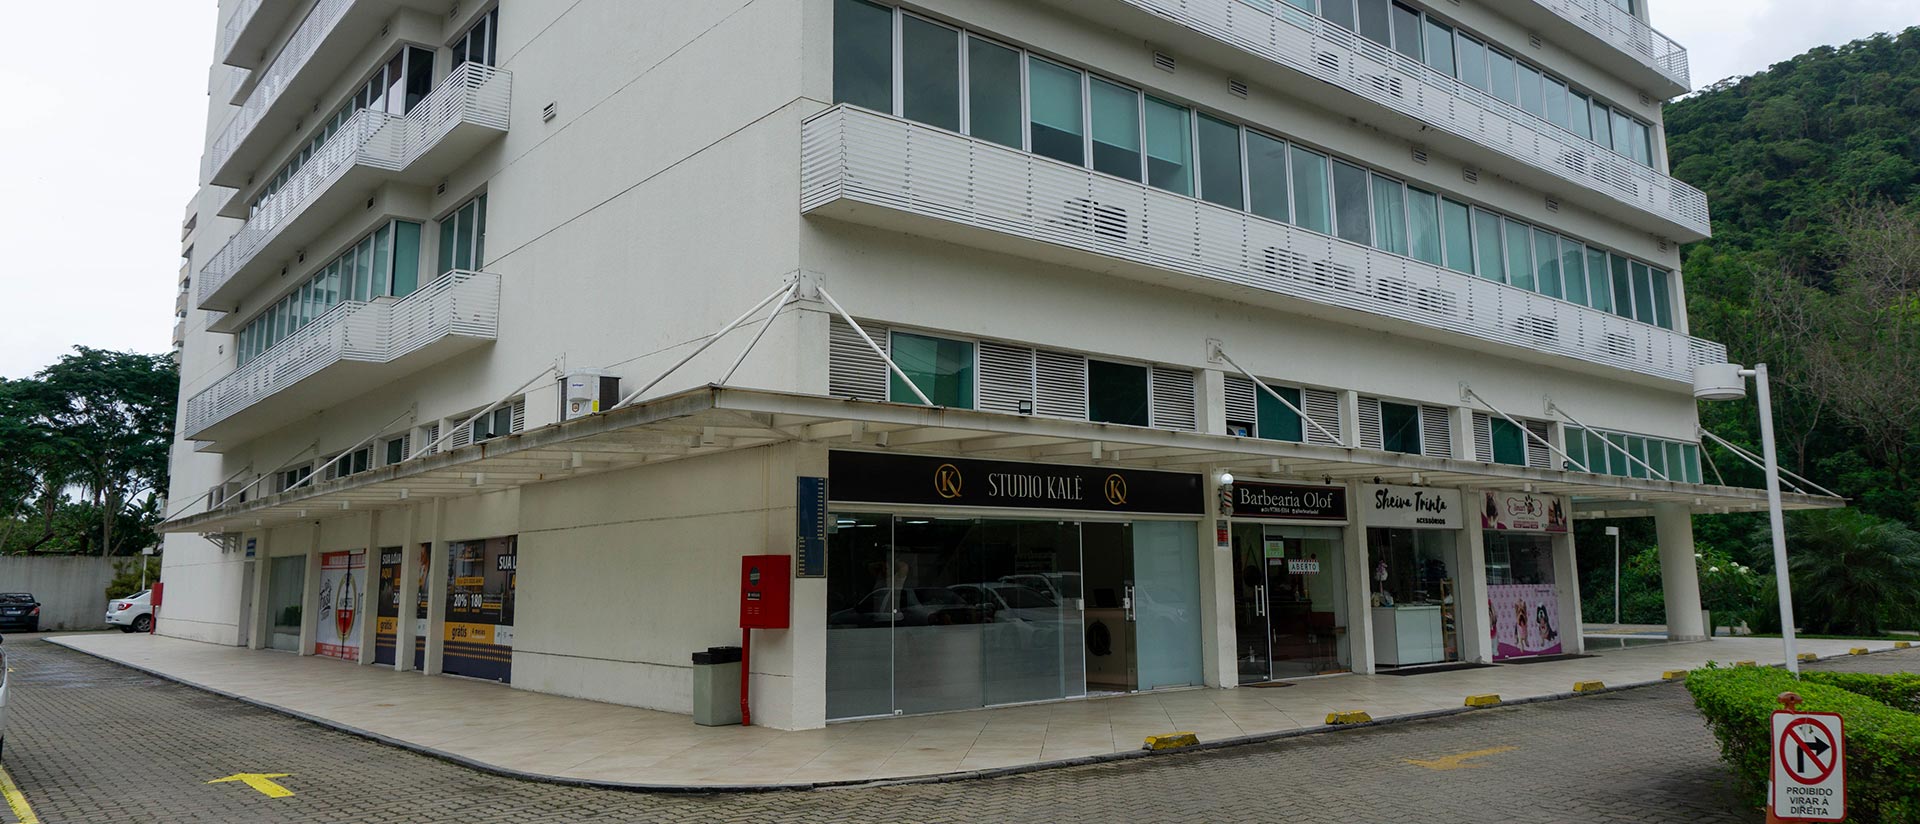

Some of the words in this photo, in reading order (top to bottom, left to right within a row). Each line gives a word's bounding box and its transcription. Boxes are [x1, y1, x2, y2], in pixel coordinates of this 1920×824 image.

[989, 473, 1042, 498] STUDIO
[1240, 488, 1301, 507] Barbearia
[1303, 491, 1334, 508] Olof
[1415, 491, 1447, 513] Trinta
[498, 555, 512, 570] SUA
[1292, 563, 1317, 571] ABERTO
[454, 593, 468, 608] 20%
[471, 593, 483, 608] 180
[1786, 787, 1833, 796] PROIBIDO
[1790, 797, 1819, 806] VIRAR
